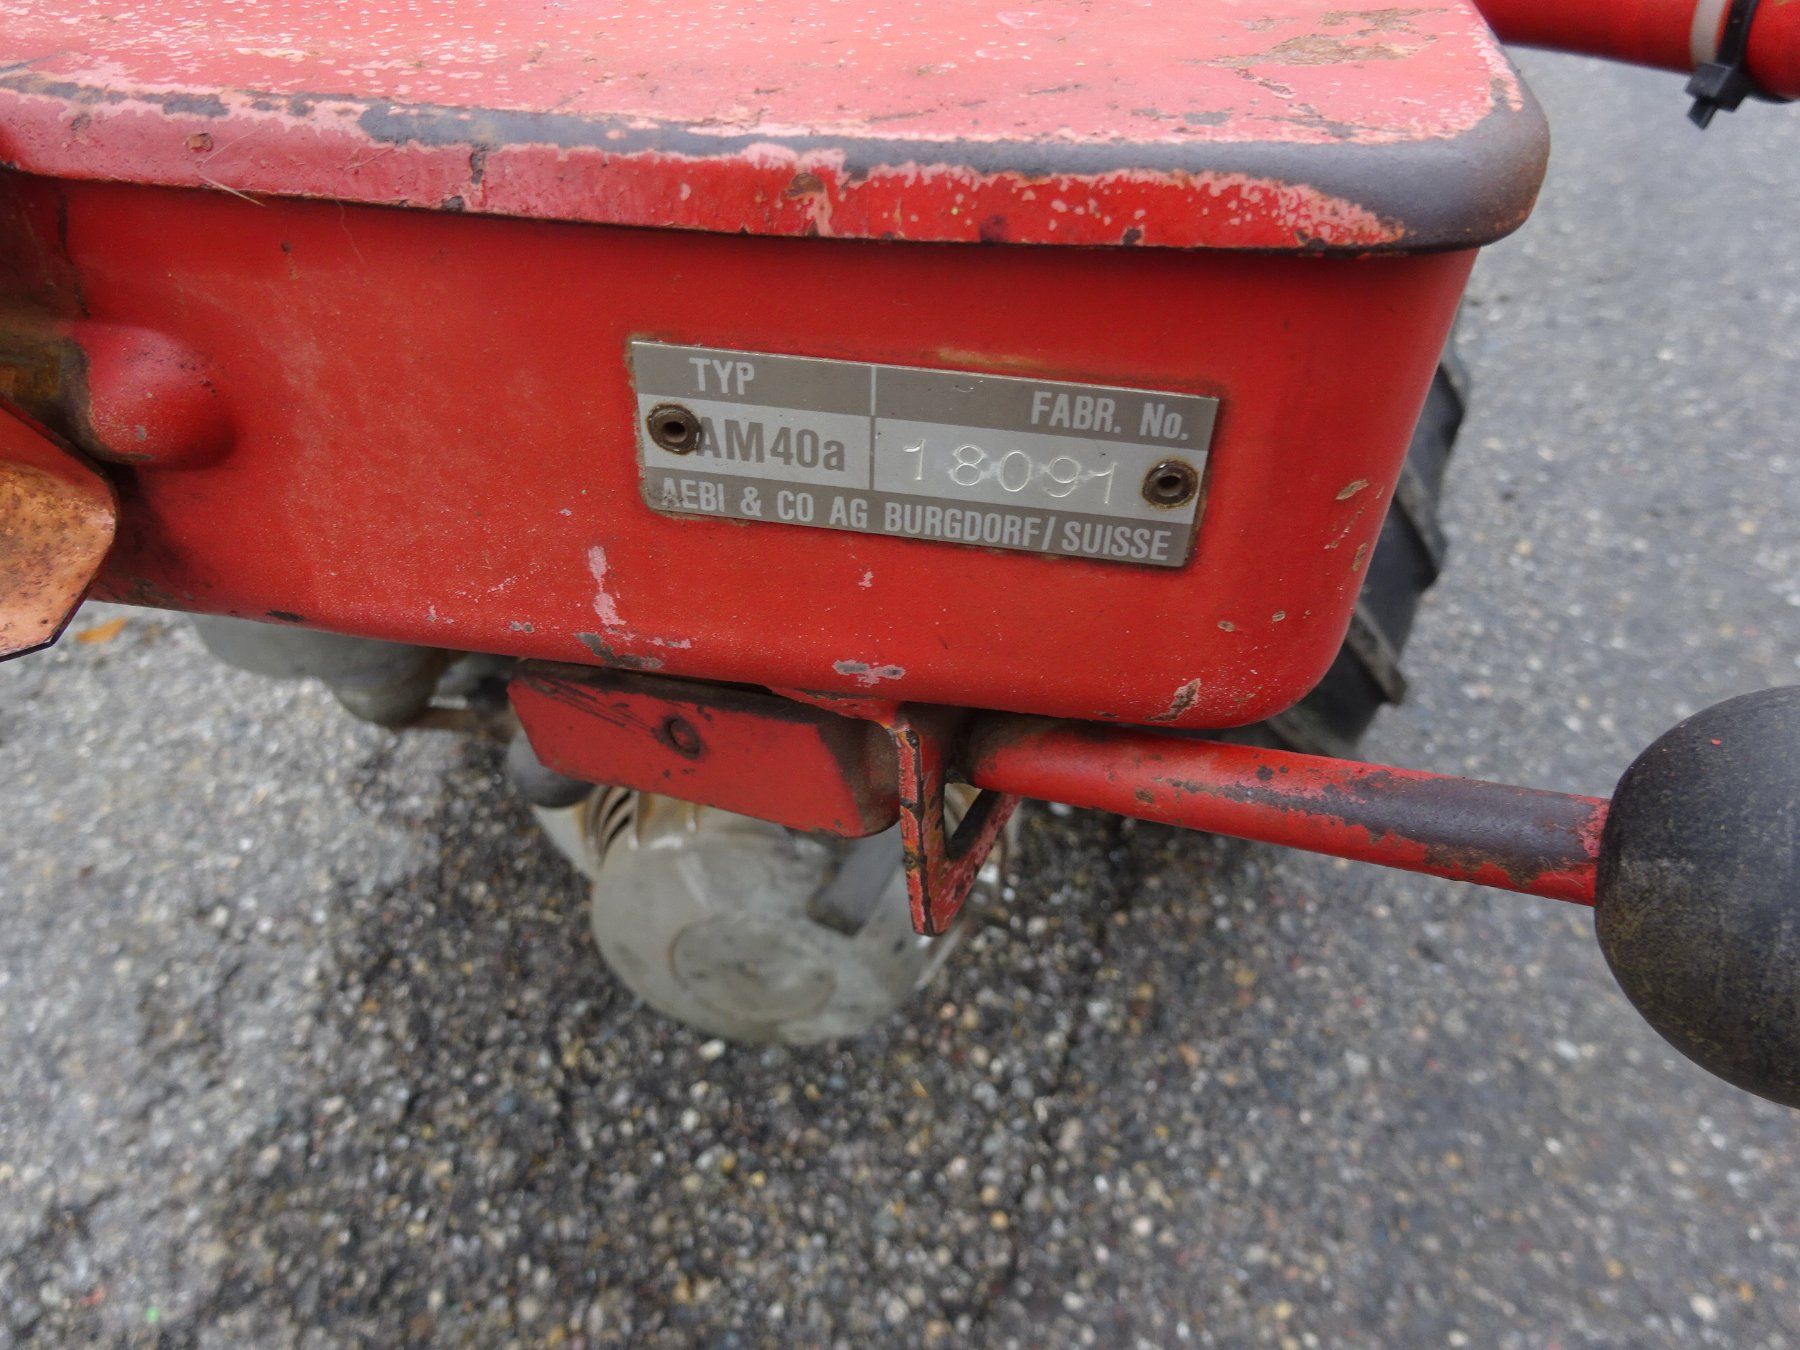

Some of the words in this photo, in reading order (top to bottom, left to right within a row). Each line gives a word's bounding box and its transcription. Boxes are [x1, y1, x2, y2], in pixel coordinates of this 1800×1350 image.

[689, 357, 755, 395] TYP
[1031, 390, 1121, 433] FABR.
[1139, 402, 1188, 440] No.
[696, 416, 846, 471] AM40a
[903, 439, 1118, 504] 18091
[661, 477, 725, 513] AEBI
[740, 486, 762, 517] &
[777, 490, 815, 523] CO
[829, 496, 868, 529] AG
